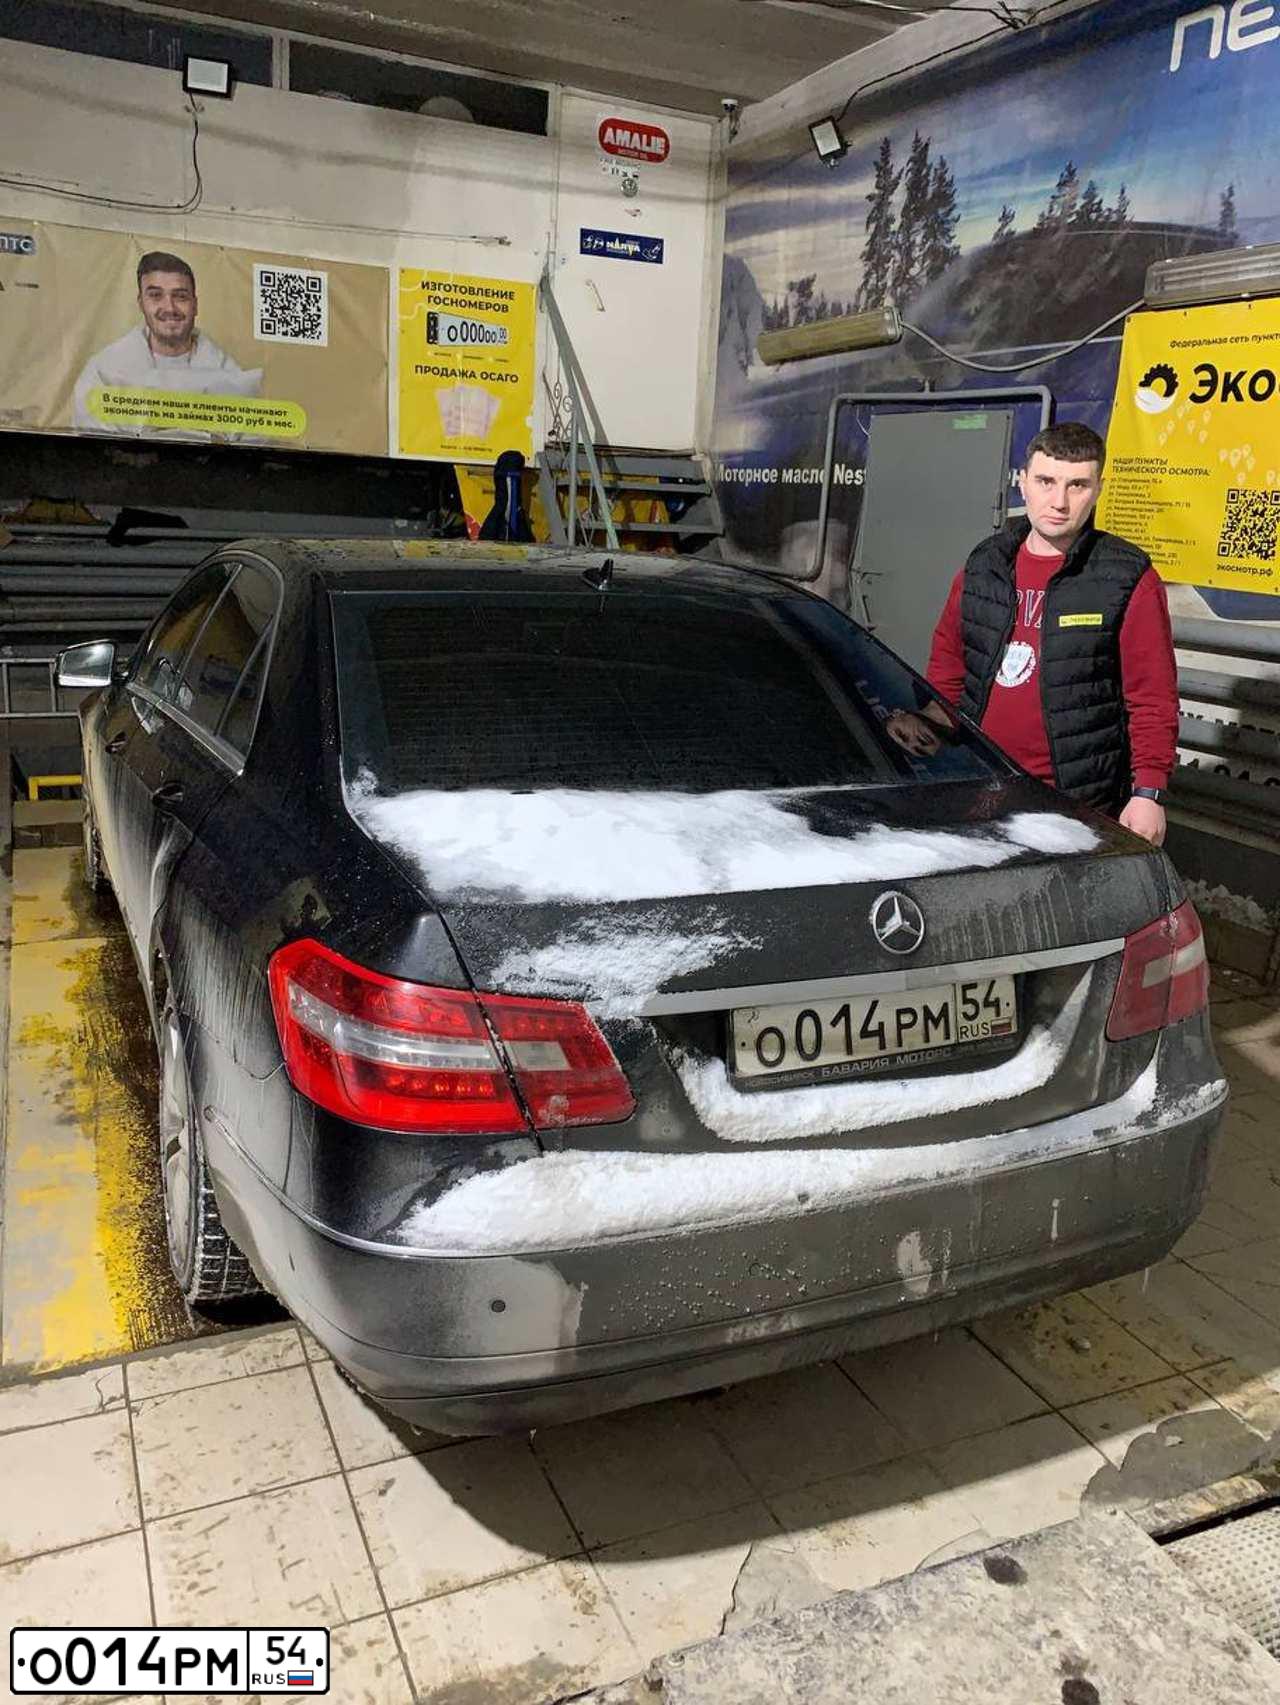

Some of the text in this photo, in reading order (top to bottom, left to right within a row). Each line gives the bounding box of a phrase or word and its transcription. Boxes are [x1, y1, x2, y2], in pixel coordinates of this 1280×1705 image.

[603, 127, 666, 155] AMALIE
[421, 281, 515, 300] ИЗГОТОВЛЕНИЕ
[427, 295, 509, 313] ГОСНОМЕРОВ
[1170, 333, 1280, 349] Федеральная сеть пункт
[415, 365, 519, 383] ПРОДАЖА ОСАГО
[1189, 362, 1280, 404] Эко
[103, 393, 288, 417] В среднем наши клиенты начинают
[103, 406, 160, 418] экономить
[162, 411, 175, 419] на
[178, 410, 214, 422] займах
[216, 413, 243, 424] 3000
[245, 416, 265, 428] руб
[834, 463, 866, 485] Nes
[961, 979, 1001, 1022] 54
[958, 1021, 990, 1039] RUS
[821, 1057, 890, 1077] БАВАРИЯ
